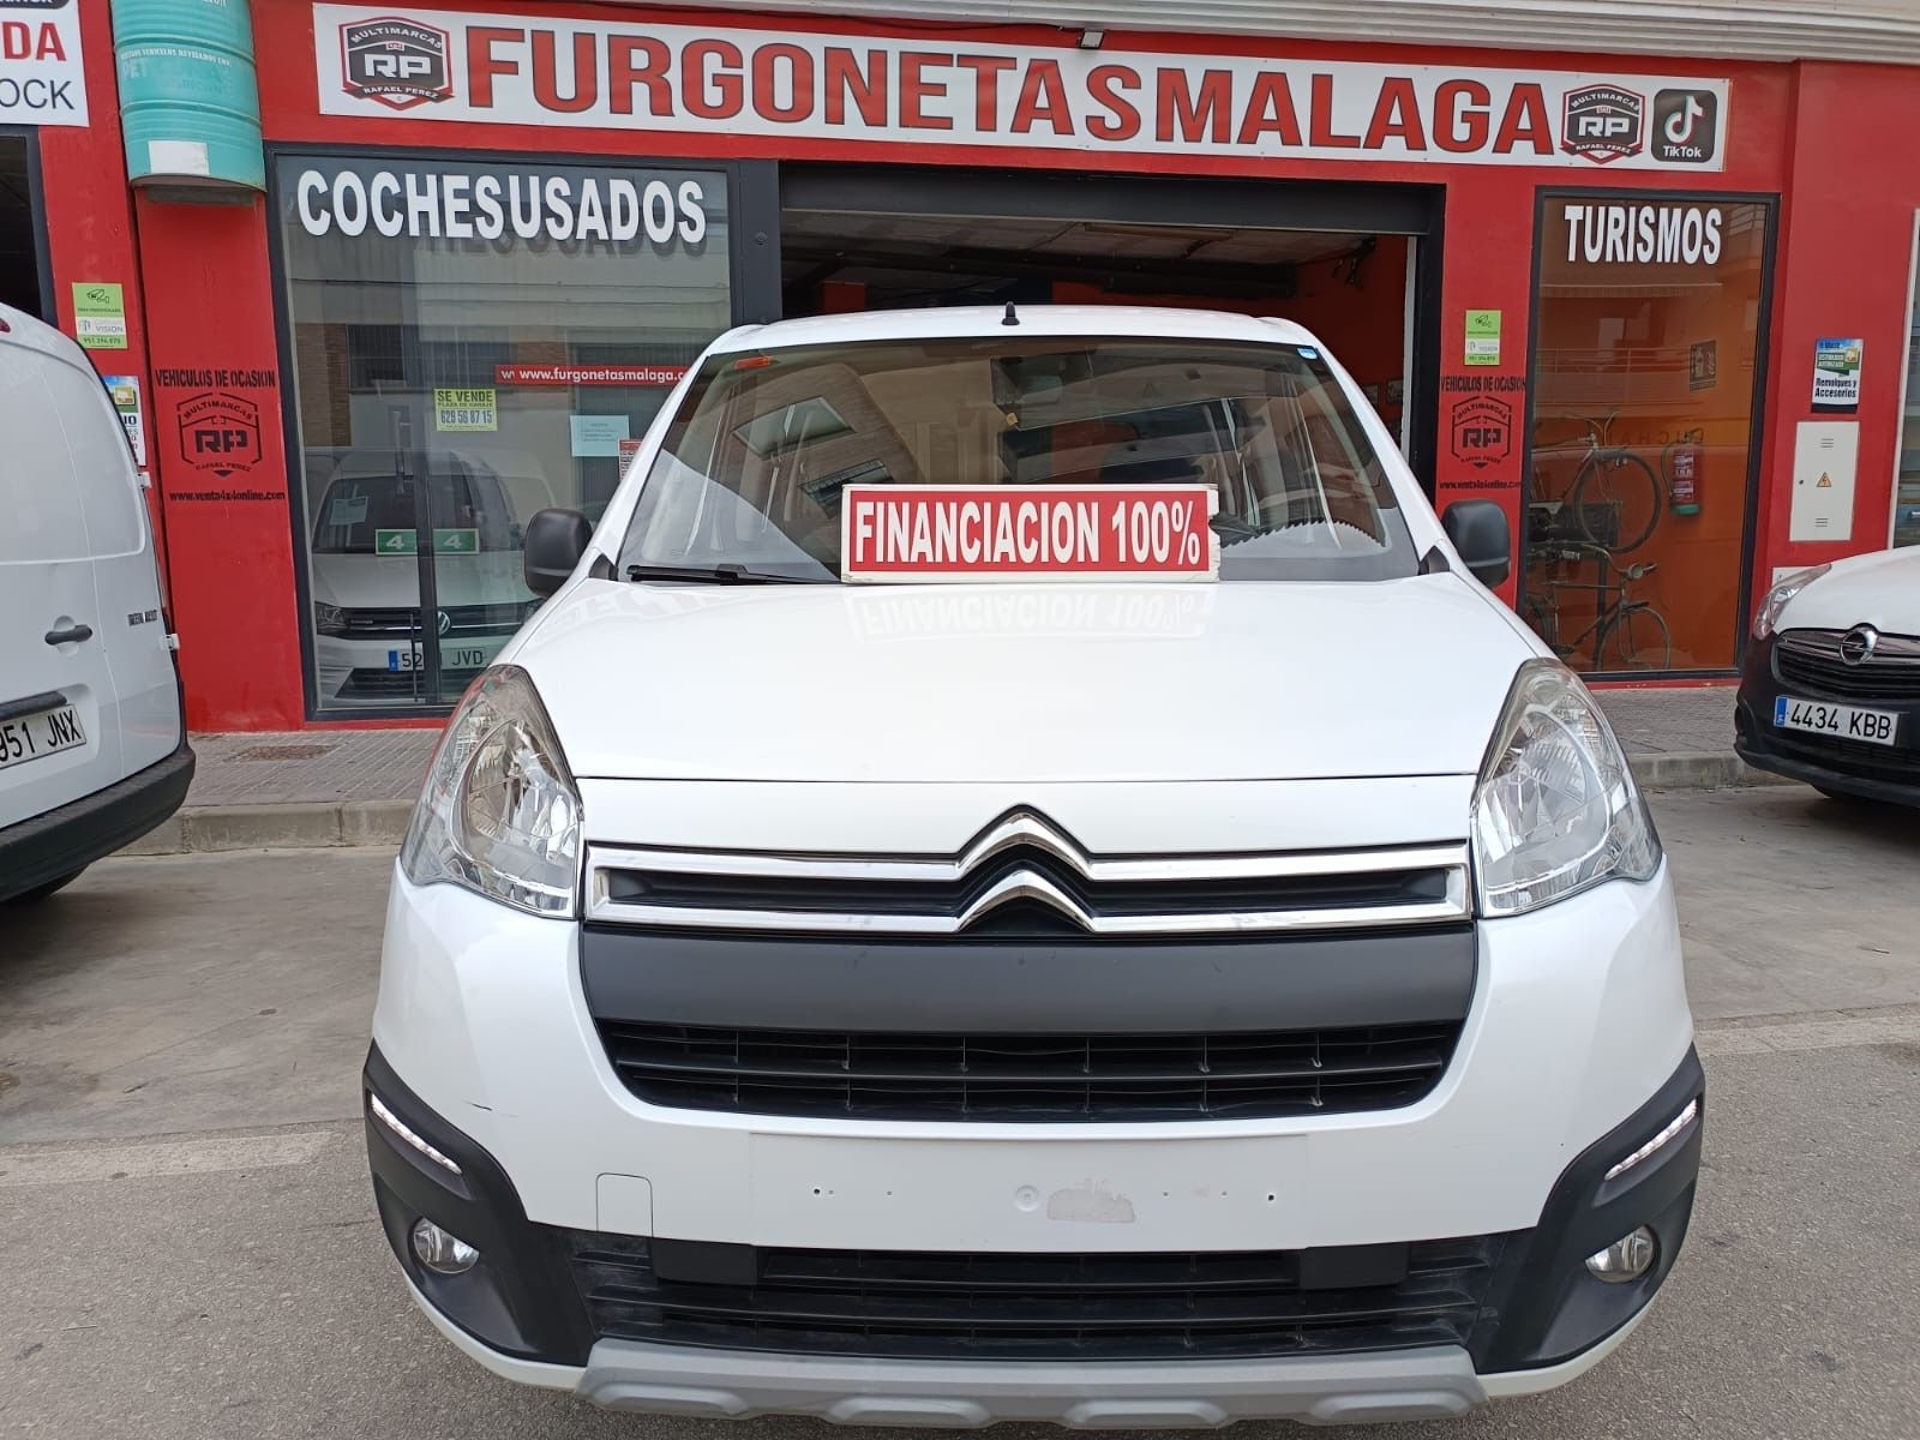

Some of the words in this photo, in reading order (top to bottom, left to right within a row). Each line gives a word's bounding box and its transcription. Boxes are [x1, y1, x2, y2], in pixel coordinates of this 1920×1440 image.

[2, 21, 67, 61] DA
[351, 27, 443, 49] MULTIMARCAS
[364, 53, 431, 78] RP
[363, 85, 402, 95] RAFAEL
[405, 85, 439, 99] PEREZ
[466, 26, 1554, 155] FURGONETASMALAGA
[1571, 93, 1640, 112] MULTIMARCAS
[1578, 116, 1630, 137] RP
[1575, 143, 1606, 151] RAFAEL
[1663, 146, 1702, 158] TikTok
[297, 170, 706, 244] COCHESUSADOS
[1564, 205, 1722, 264] TURISMOS
[155, 369, 212, 387] VEHICULOS
[215, 370, 229, 387] DE
[230, 370, 276, 388] OCASION
[1441, 375, 1482, 392] VEHICULOS
[1483, 376, 1494, 392] DE
[437, 390, 452, 402] SE
[455, 390, 493, 402] VENDE
[1815, 388, 1857, 398] Accesorios
[183, 400, 253, 420] MULTIMARCAS
[194, 430, 248, 453] RP
[1462, 428, 1501, 448] RP
[855, 501, 1100, 565] FINANCIACION
[1112, 501, 1200, 565] 100%
[452, 650, 484, 666] JVD
[47, 709, 82, 747] JNX
[1790, 703, 1840, 731] 4434
[1849, 711, 1892, 739] KBB
